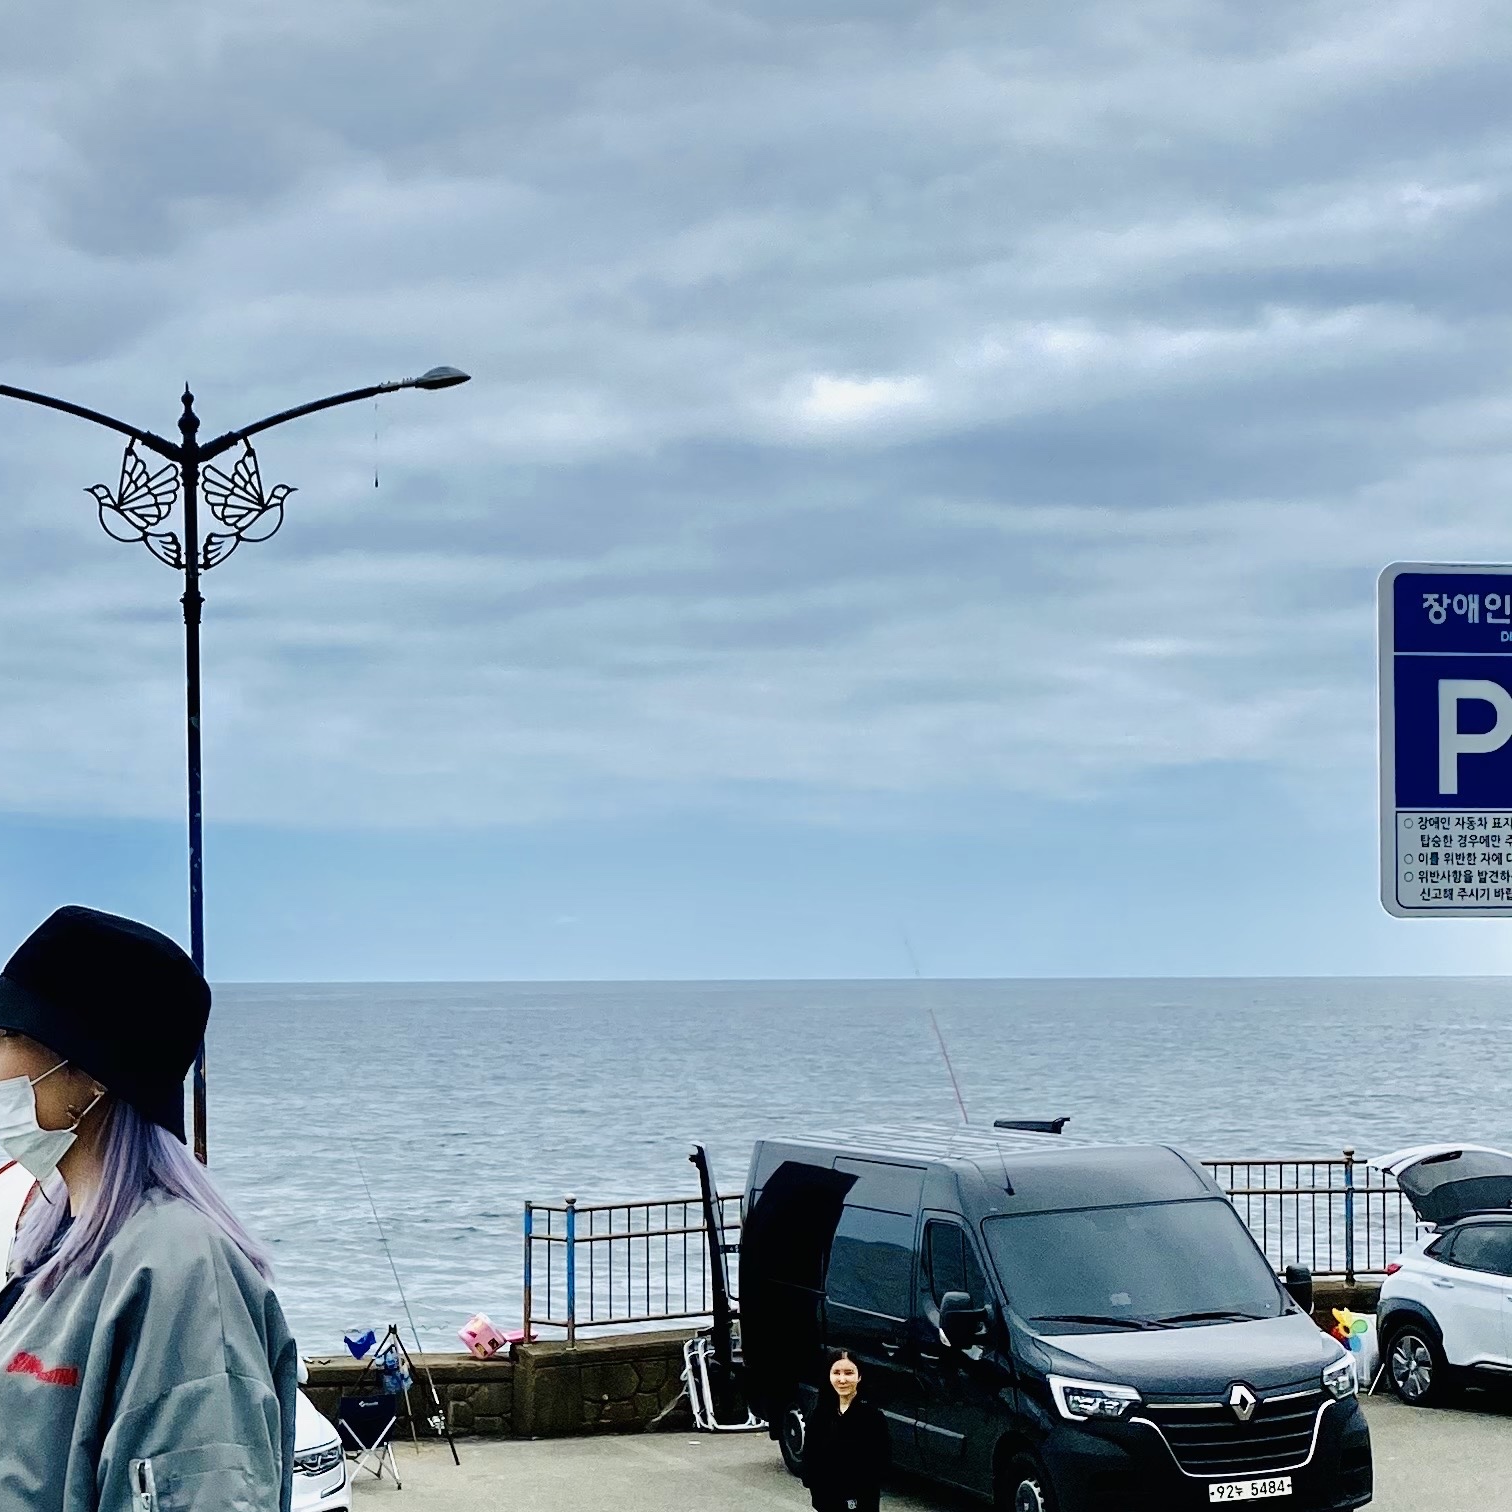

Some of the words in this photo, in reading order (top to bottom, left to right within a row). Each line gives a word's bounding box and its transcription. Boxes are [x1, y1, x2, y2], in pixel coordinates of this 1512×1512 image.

[1422, 593, 1511, 625] 장애인
[1438, 679, 1512, 794] P
[1455, 816, 1488, 830] 자동차
[1458, 834, 1501, 848] 경우에만
[1443, 852, 1477, 866] 위반한
[1480, 852, 1503, 866] 자에
[1418, 869, 1474, 884] 위반사항을
[1457, 887, 1490, 901] 주시기
[1216, 1484, 1243, 1499] 92누
[1251, 1480, 1285, 1497] 5484
